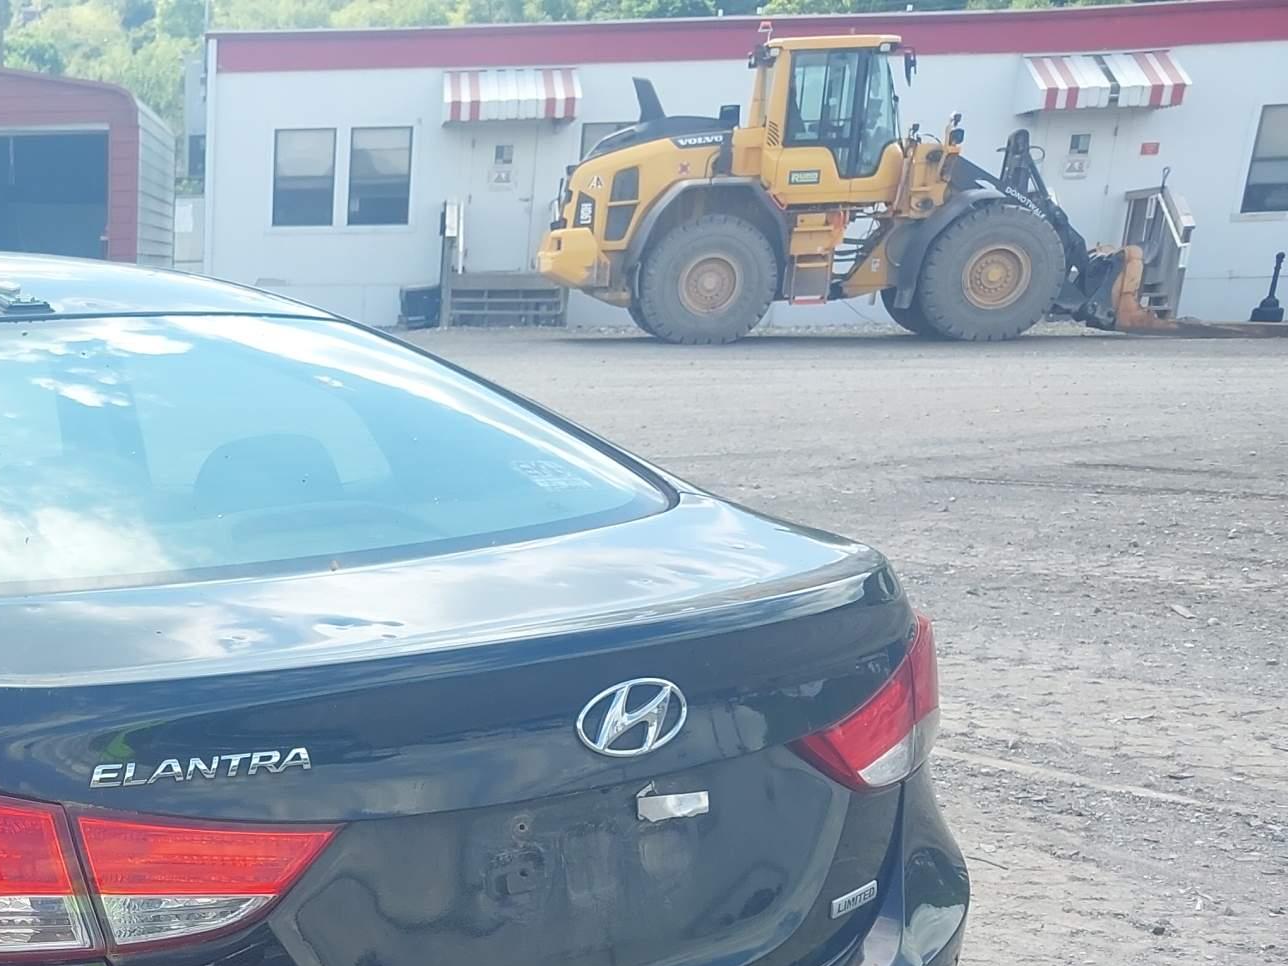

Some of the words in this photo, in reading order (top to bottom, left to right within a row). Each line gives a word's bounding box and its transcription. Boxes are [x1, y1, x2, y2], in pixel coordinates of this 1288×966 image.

[677, 135, 723, 146] VOLVO
[89, 746, 313, 789] ELANTRA
[837, 887, 875, 914] LIMITED
